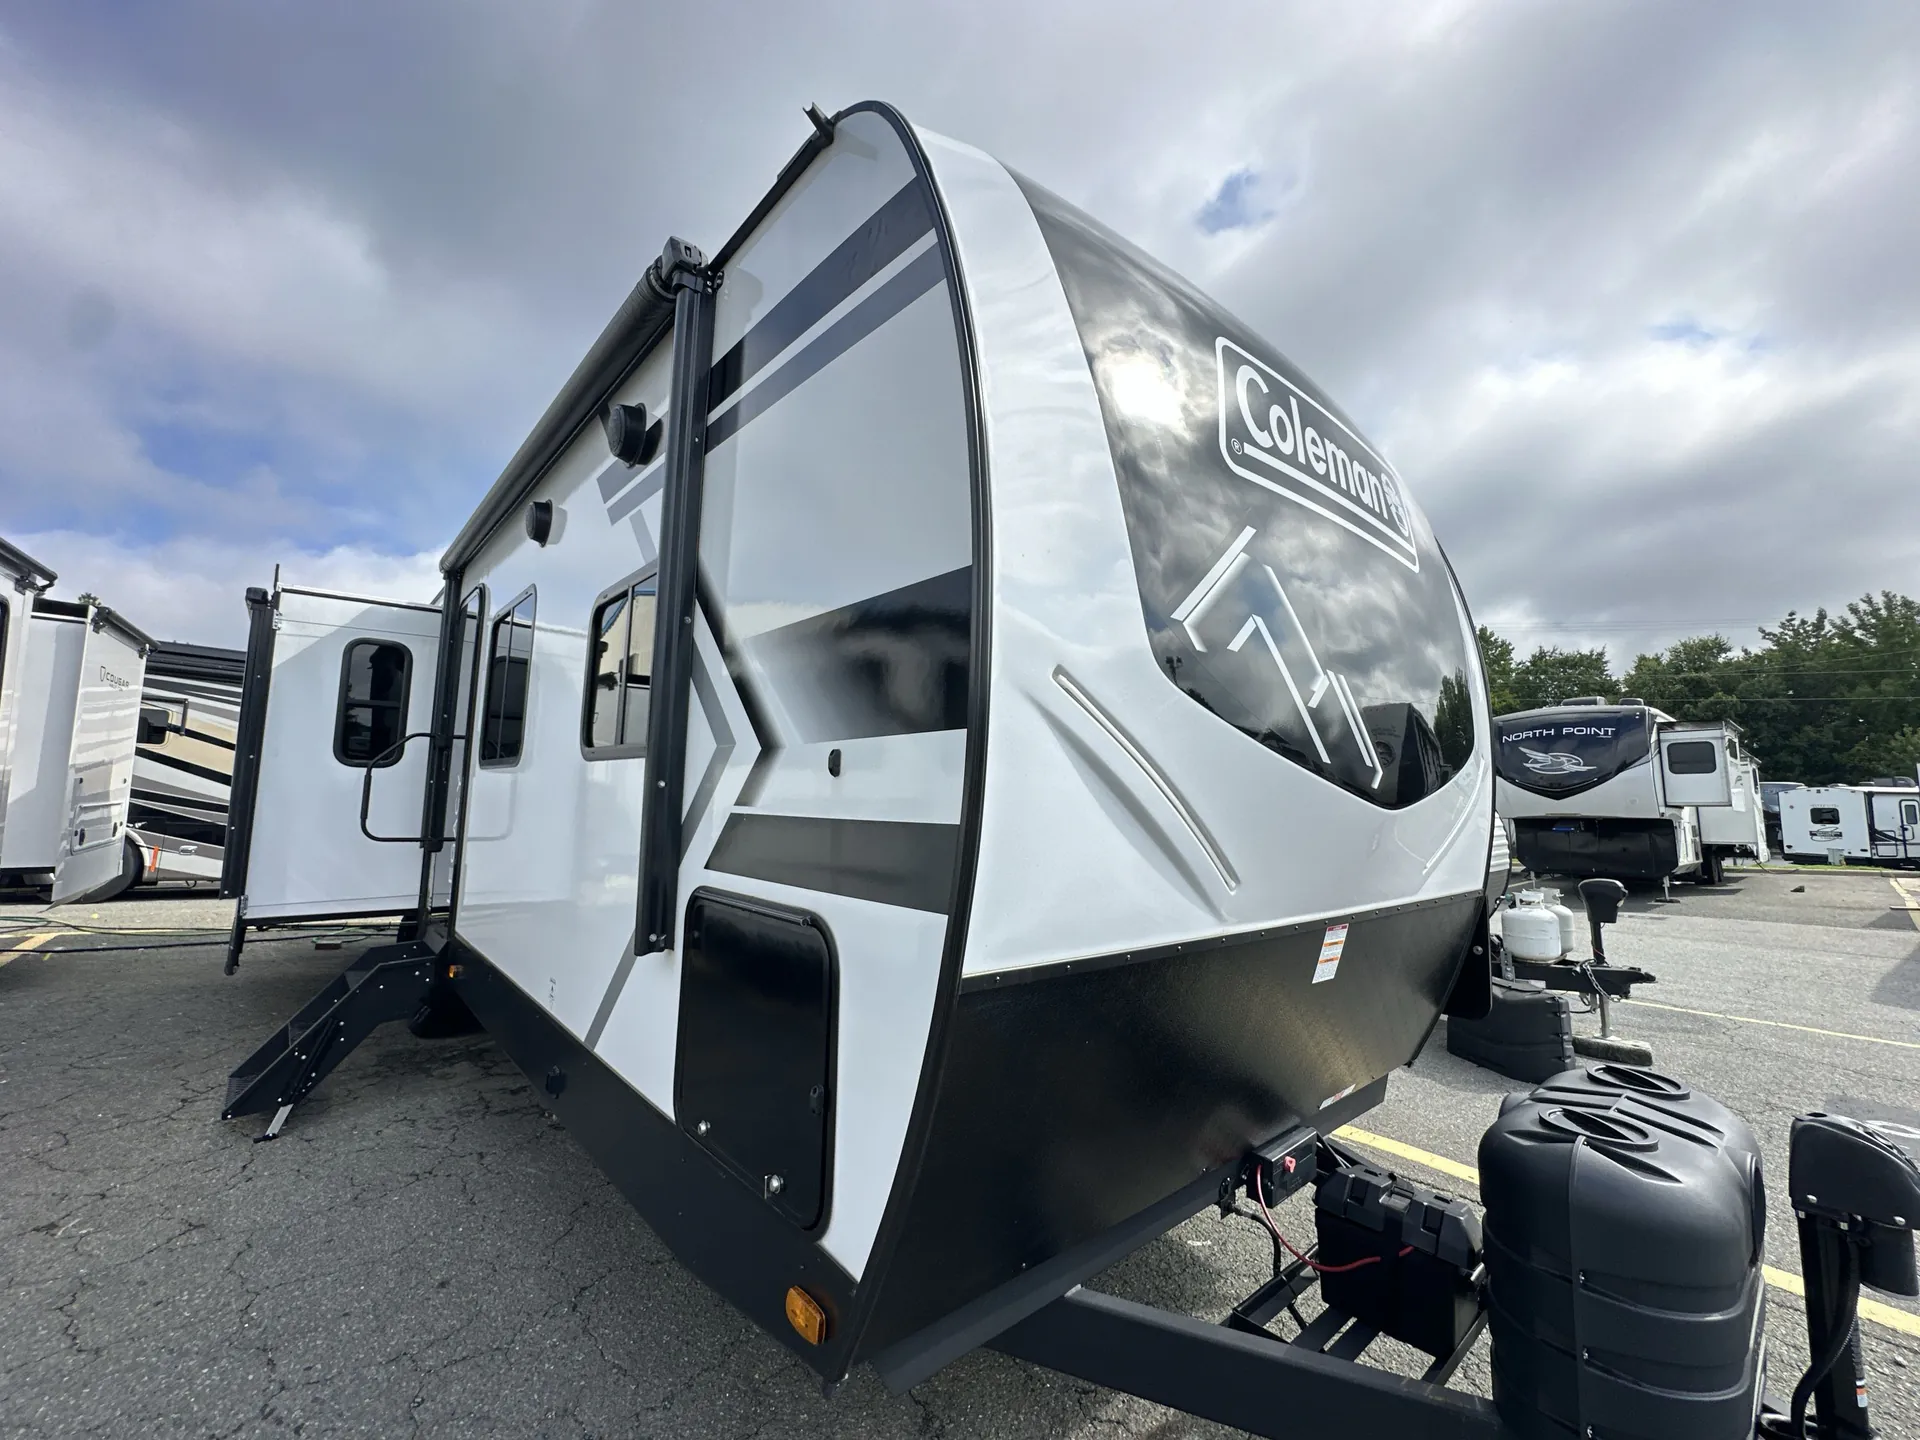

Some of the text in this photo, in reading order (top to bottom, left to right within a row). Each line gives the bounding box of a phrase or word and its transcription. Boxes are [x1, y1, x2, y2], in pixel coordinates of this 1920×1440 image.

[1236, 365, 1388, 519] Coleman
[106, 672, 129, 687] COUGAR
[1502, 727, 1616, 743] NORTH POINT
